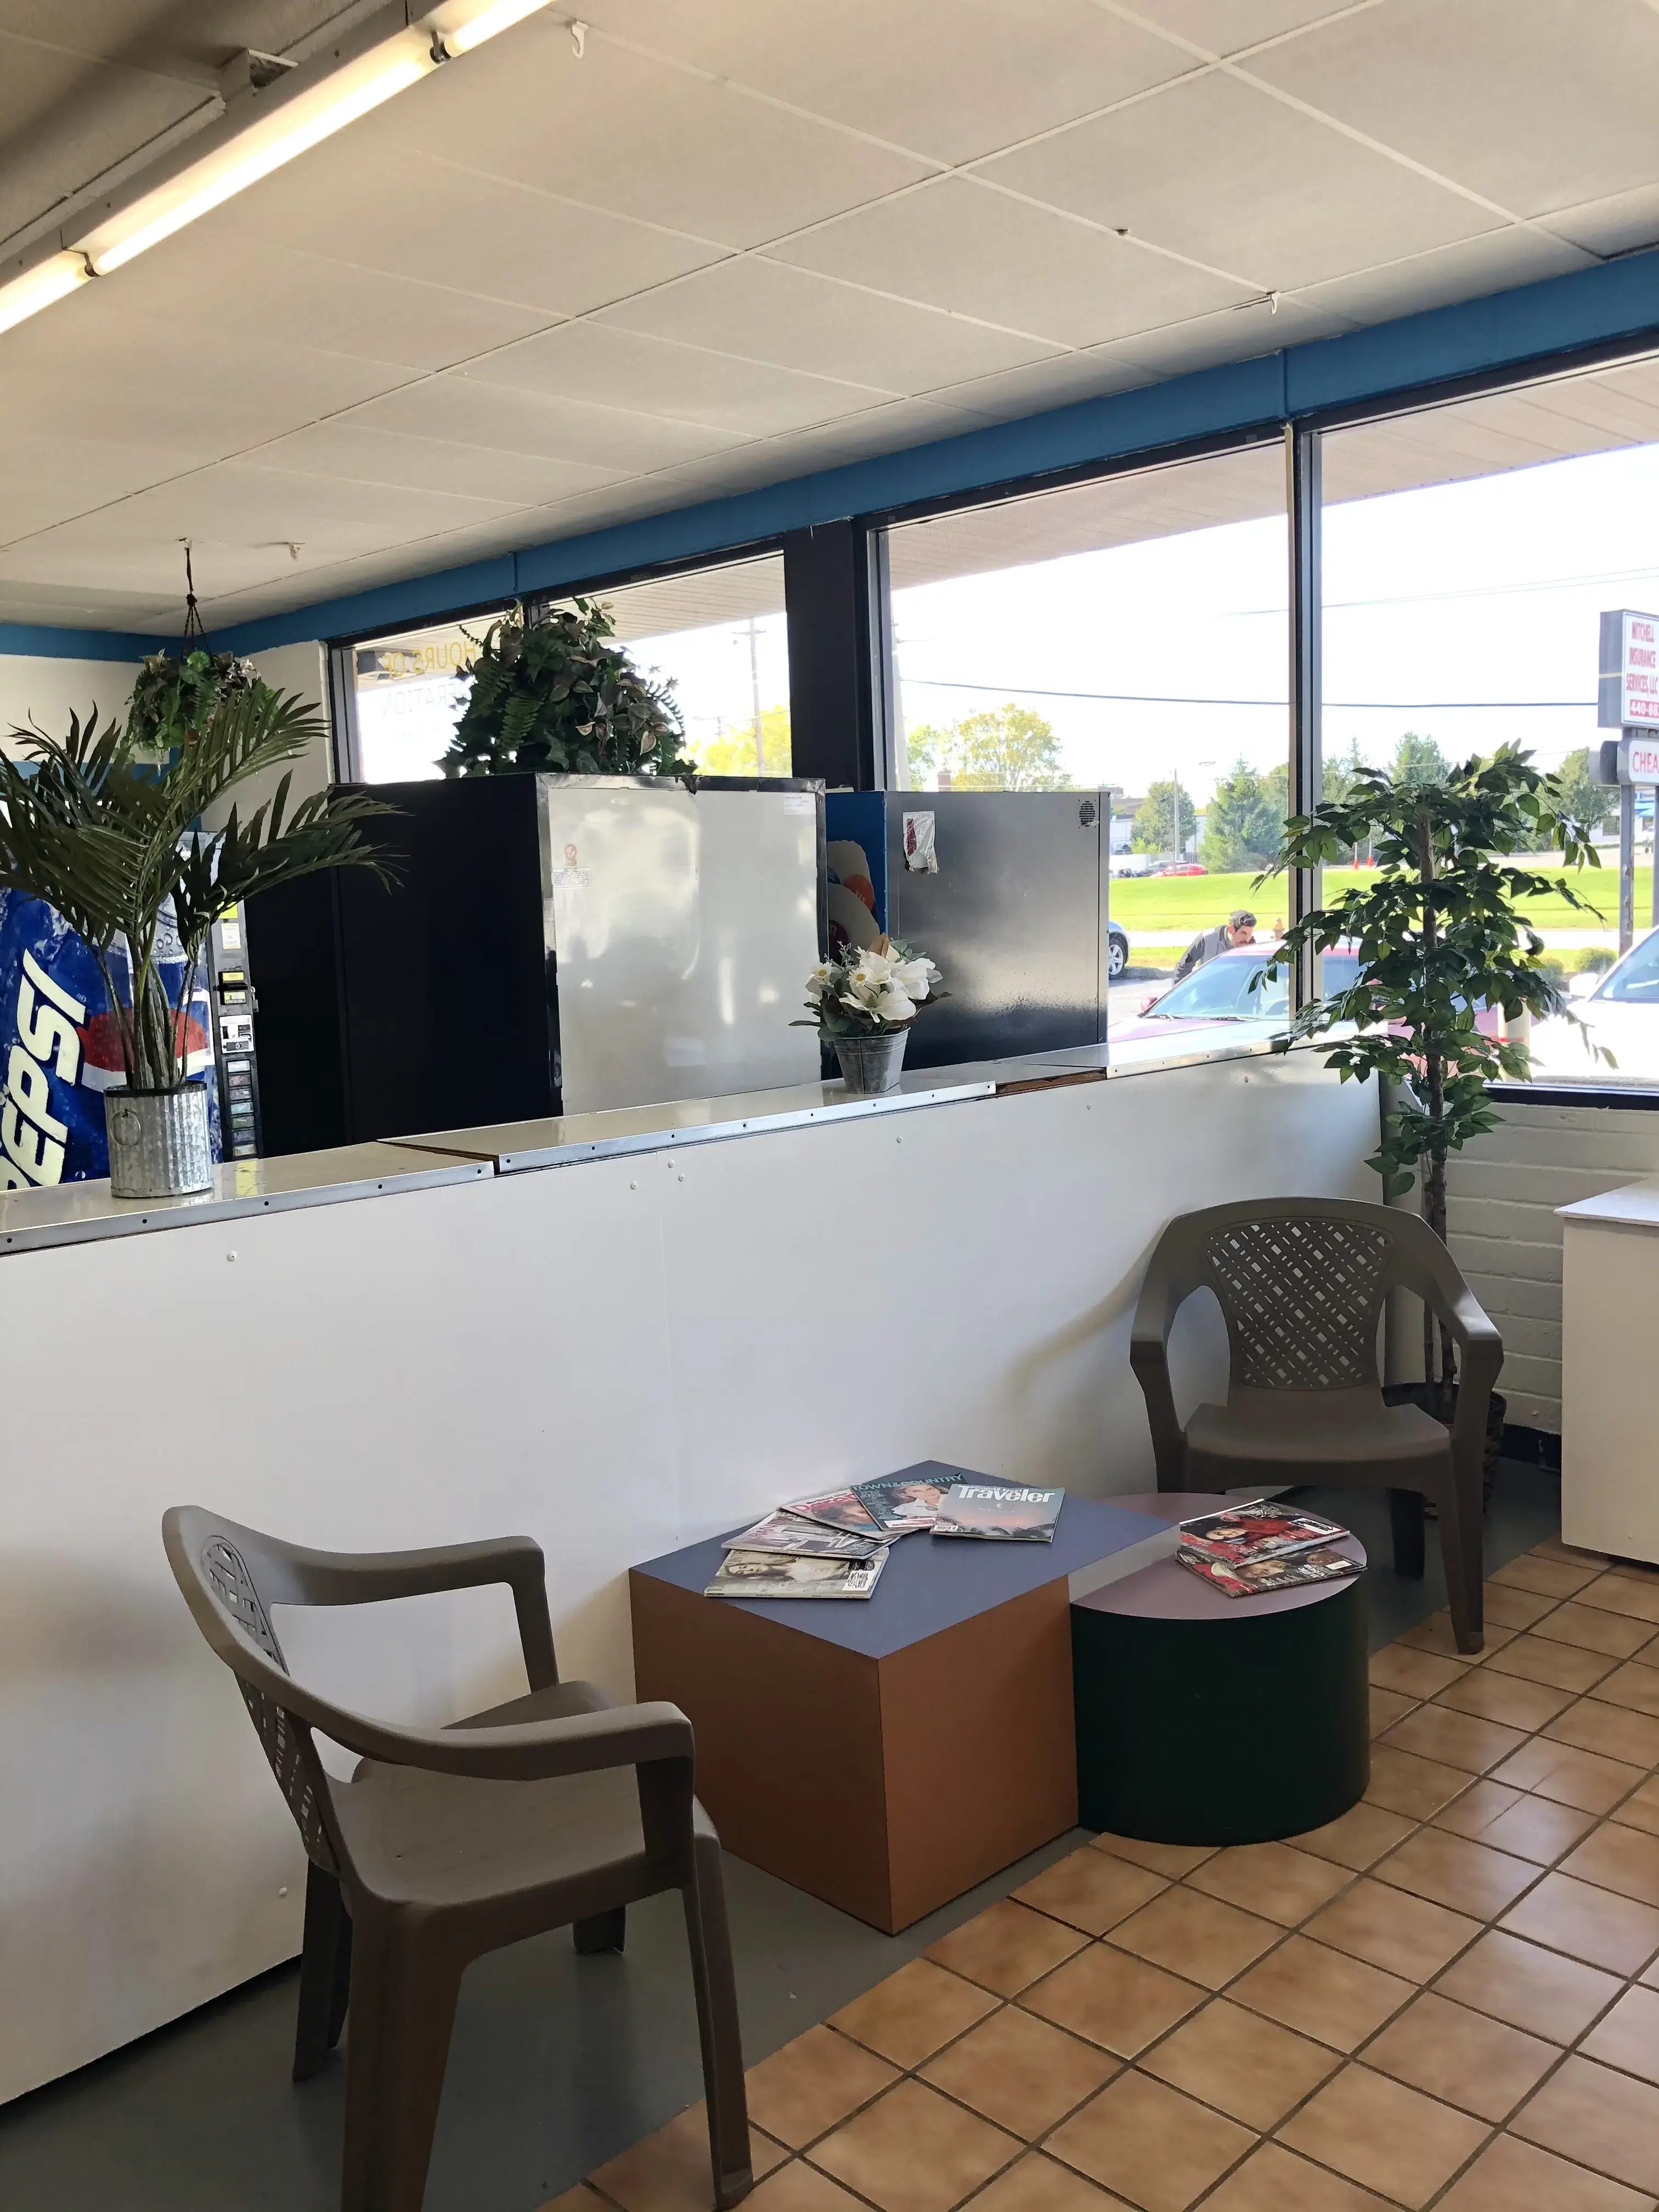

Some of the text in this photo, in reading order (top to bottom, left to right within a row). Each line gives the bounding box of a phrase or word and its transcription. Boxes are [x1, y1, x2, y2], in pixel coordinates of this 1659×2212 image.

[1632, 621, 1654, 643] MITCHELL
[1629, 646, 1656, 668] INSURANCE
[1650, 675, 1658, 695] LLC
[958, 1485, 1056, 1503] Traveler
